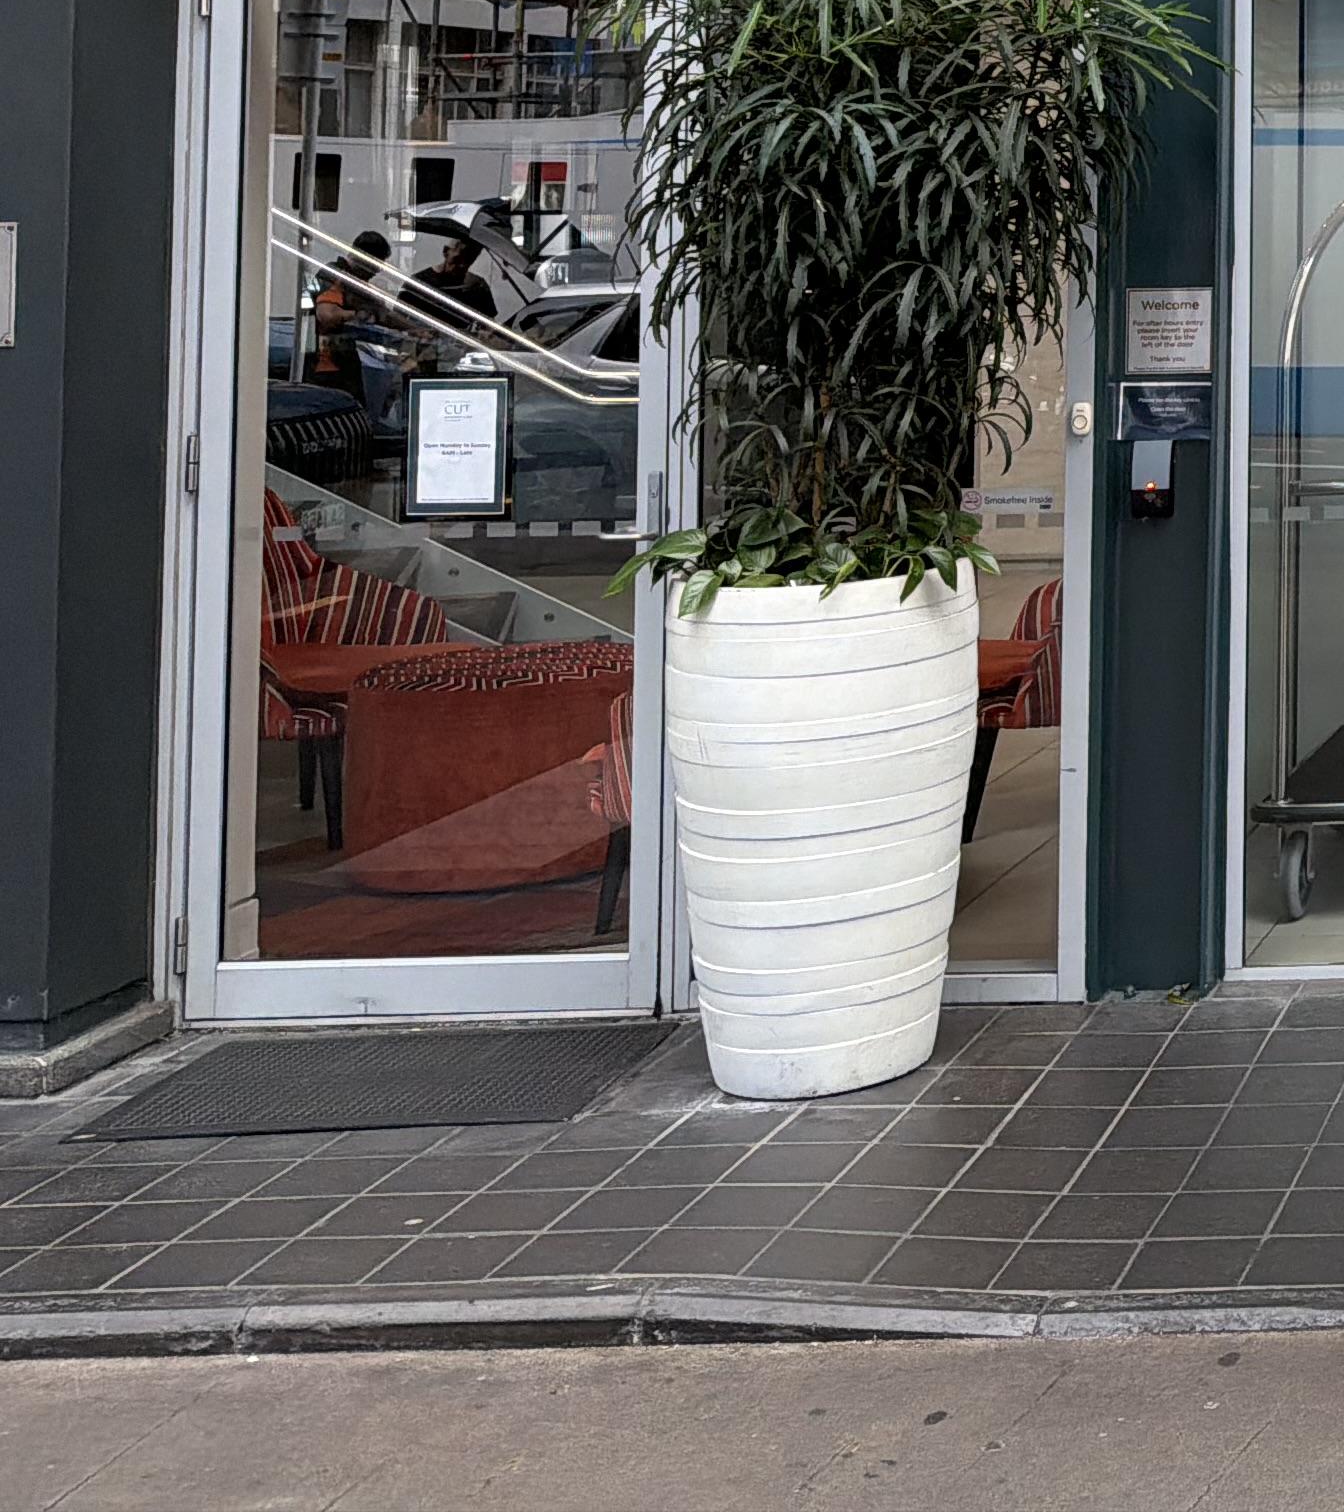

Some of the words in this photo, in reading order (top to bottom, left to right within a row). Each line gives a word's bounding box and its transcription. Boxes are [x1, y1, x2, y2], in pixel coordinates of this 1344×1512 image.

[1141, 299, 1200, 311] Welcome
[1185, 319, 1204, 328] entry
[1137, 327, 1160, 335] please
[1182, 328, 1199, 336] your
[1160, 334, 1172, 342] key
[1141, 341, 1153, 349] left
[1164, 341, 1175, 349] the
[1176, 341, 1194, 349] door
[444, 404, 470, 415] CUT
[984, 495, 1027, 505] Smokefree
